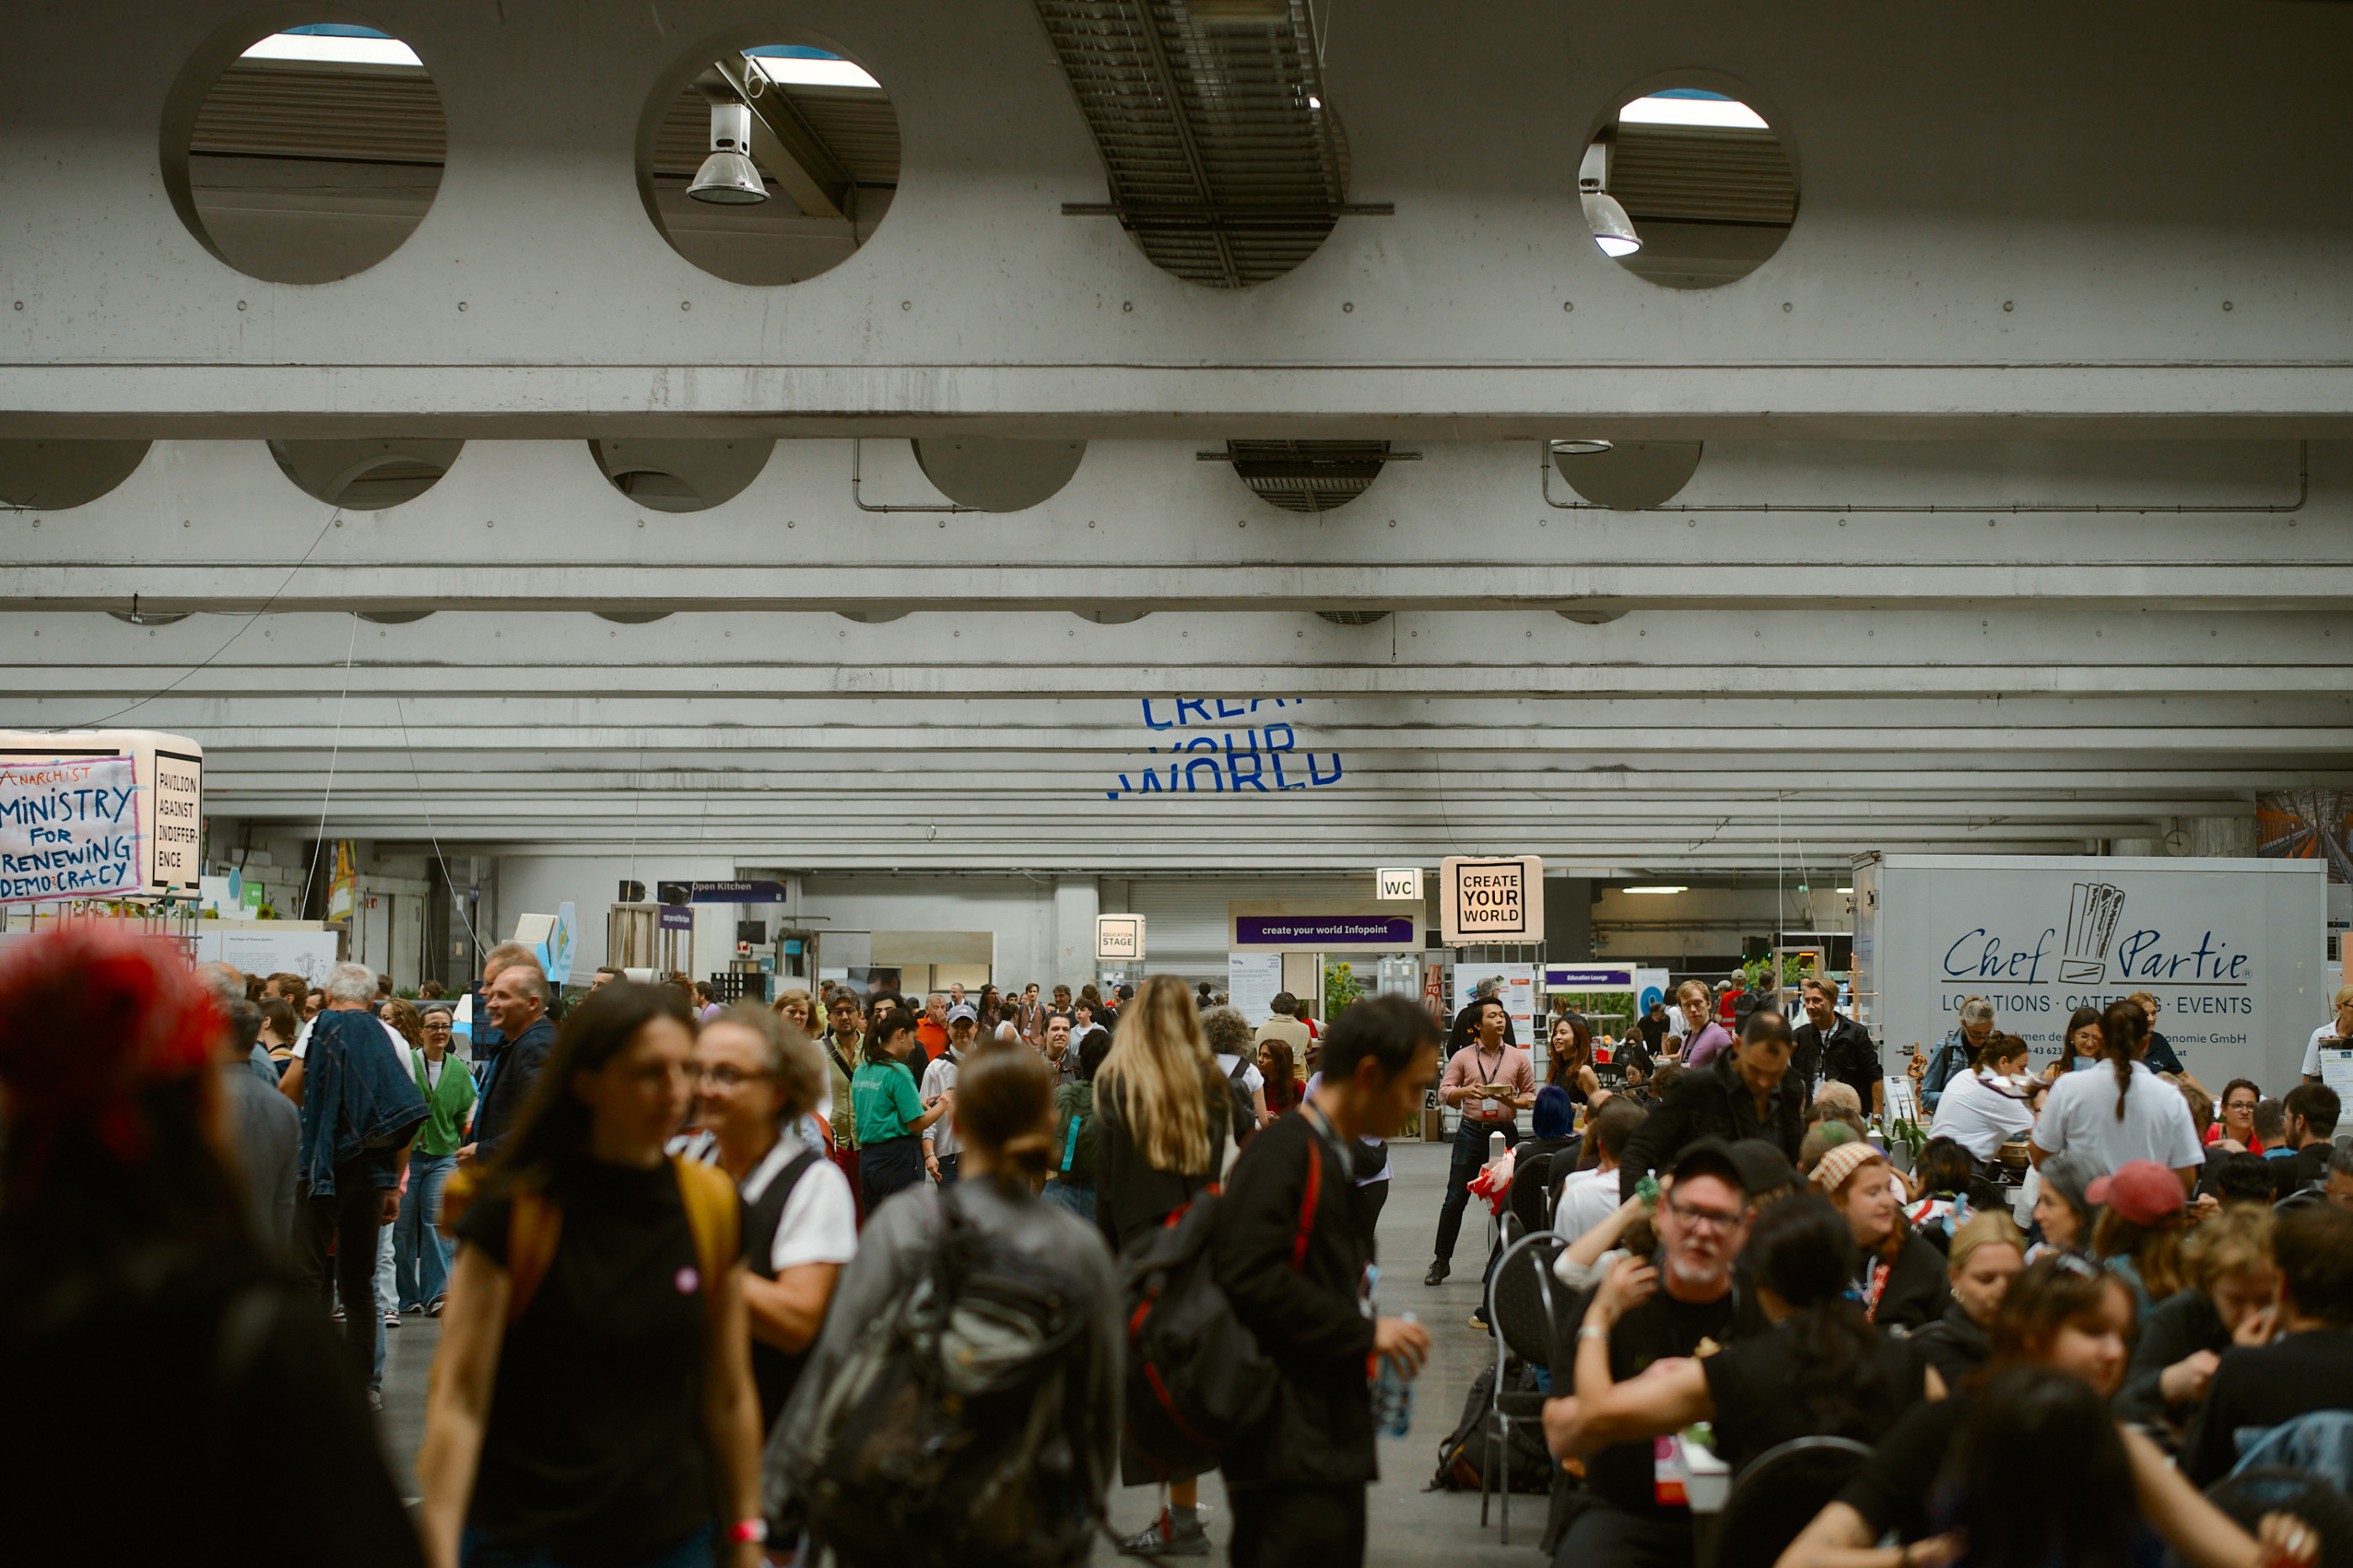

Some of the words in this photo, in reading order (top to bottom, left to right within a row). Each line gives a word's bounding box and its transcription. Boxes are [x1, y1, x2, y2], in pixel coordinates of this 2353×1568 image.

[160, 773, 197, 793] PAVILION
[159, 799, 193, 818] AGAINST
[30, 827, 73, 847] FOR
[159, 825, 197, 844] INDIFFER-
[159, 851, 182, 868] ENCE
[692, 882, 715, 892] Open
[717, 881, 752, 891] Kitchen
[1385, 881, 1412, 895] WC
[1464, 875, 1518, 887] CREATE
[1464, 890, 1518, 906] YOUR
[1464, 909, 1519, 922] WORLD
[1262, 926, 1292, 934] create
[1293, 928, 1313, 937] your
[1316, 925, 1342, 934] world
[1345, 925, 1387, 936] Infopoint
[1944, 929, 2055, 985] Chef
[1428, 986, 1439, 994] TO
[1943, 994, 2050, 1013] LOTIONS
[2177, 997, 2251, 1014] EVENTS
[2210, 1033, 2246, 1043] GmbH
